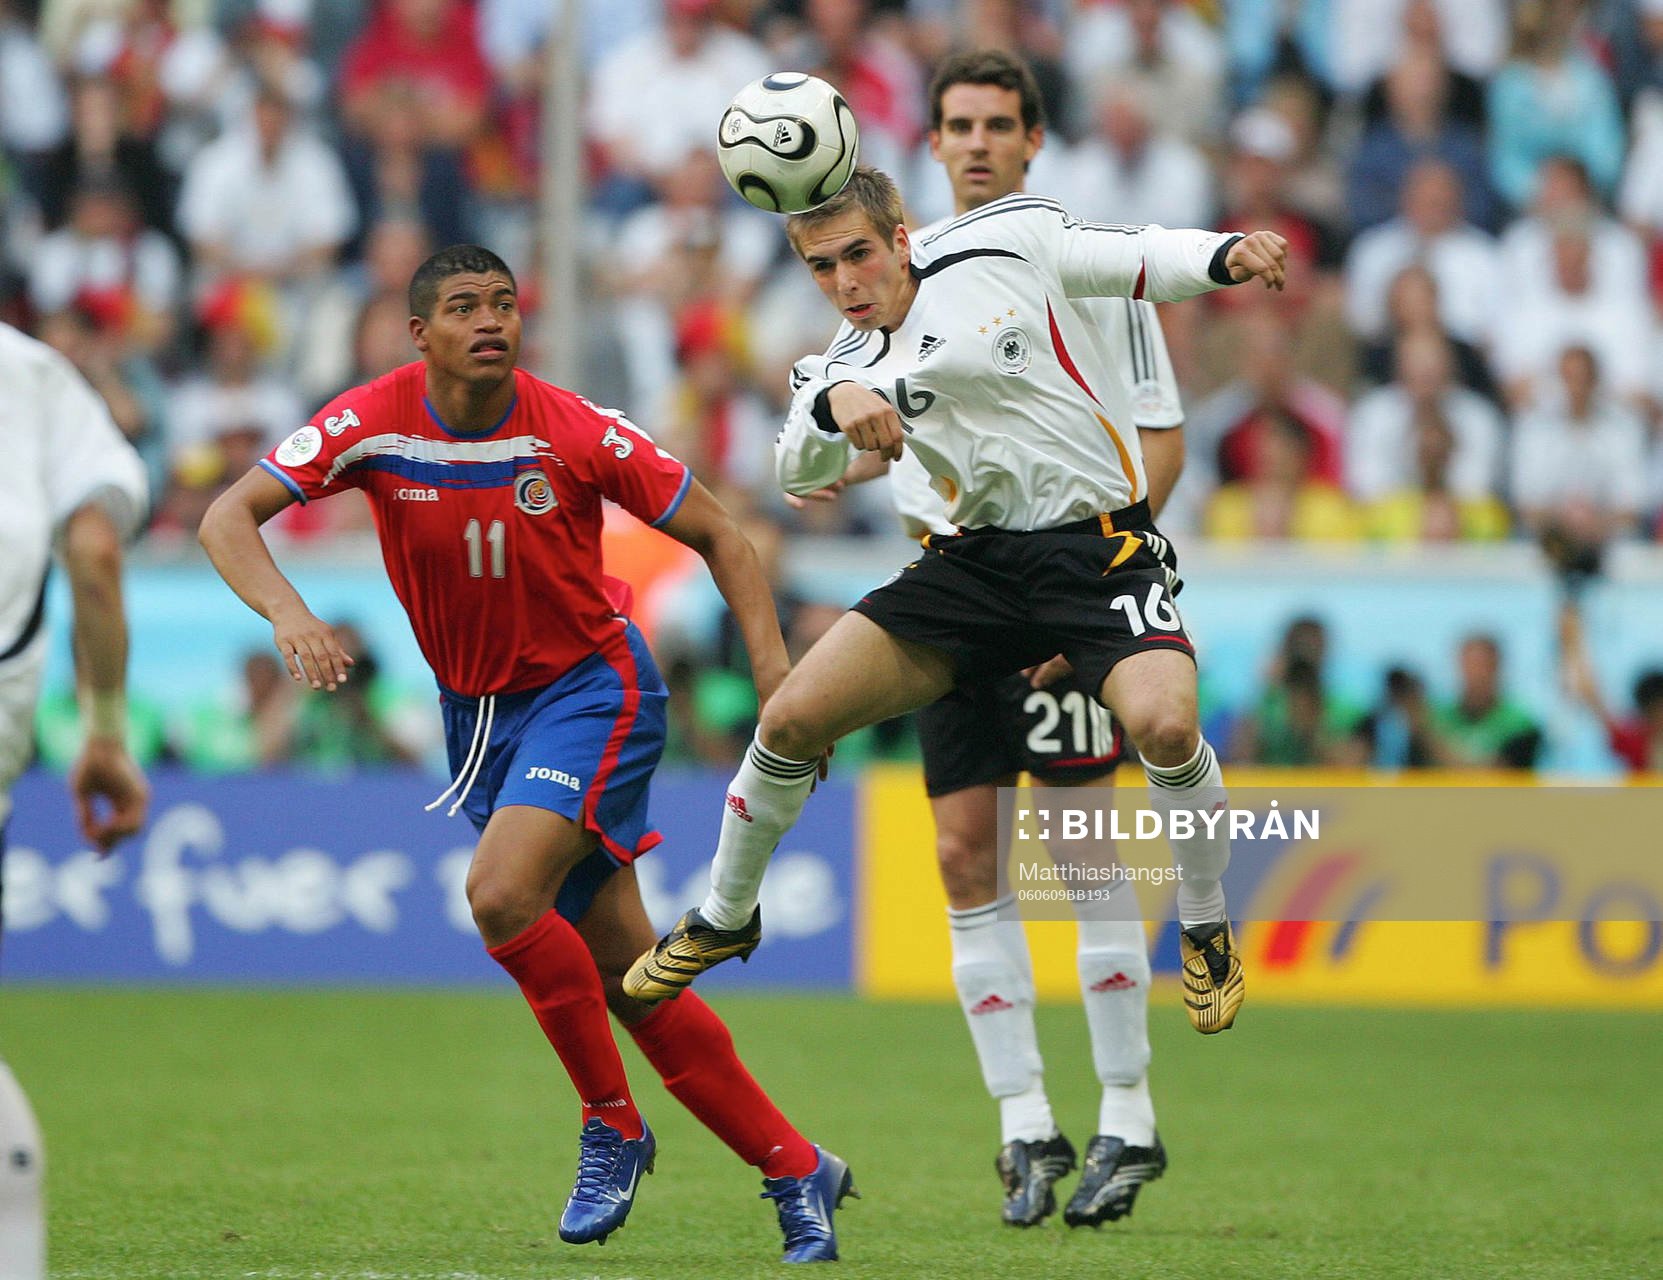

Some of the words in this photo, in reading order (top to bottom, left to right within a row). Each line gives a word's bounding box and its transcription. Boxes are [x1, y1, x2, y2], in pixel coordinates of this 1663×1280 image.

[918, 337, 947, 363] adidas
[464, 518, 506, 578] 11
[1109, 582, 1182, 637] 16
[1023, 690, 1088, 753] 21
